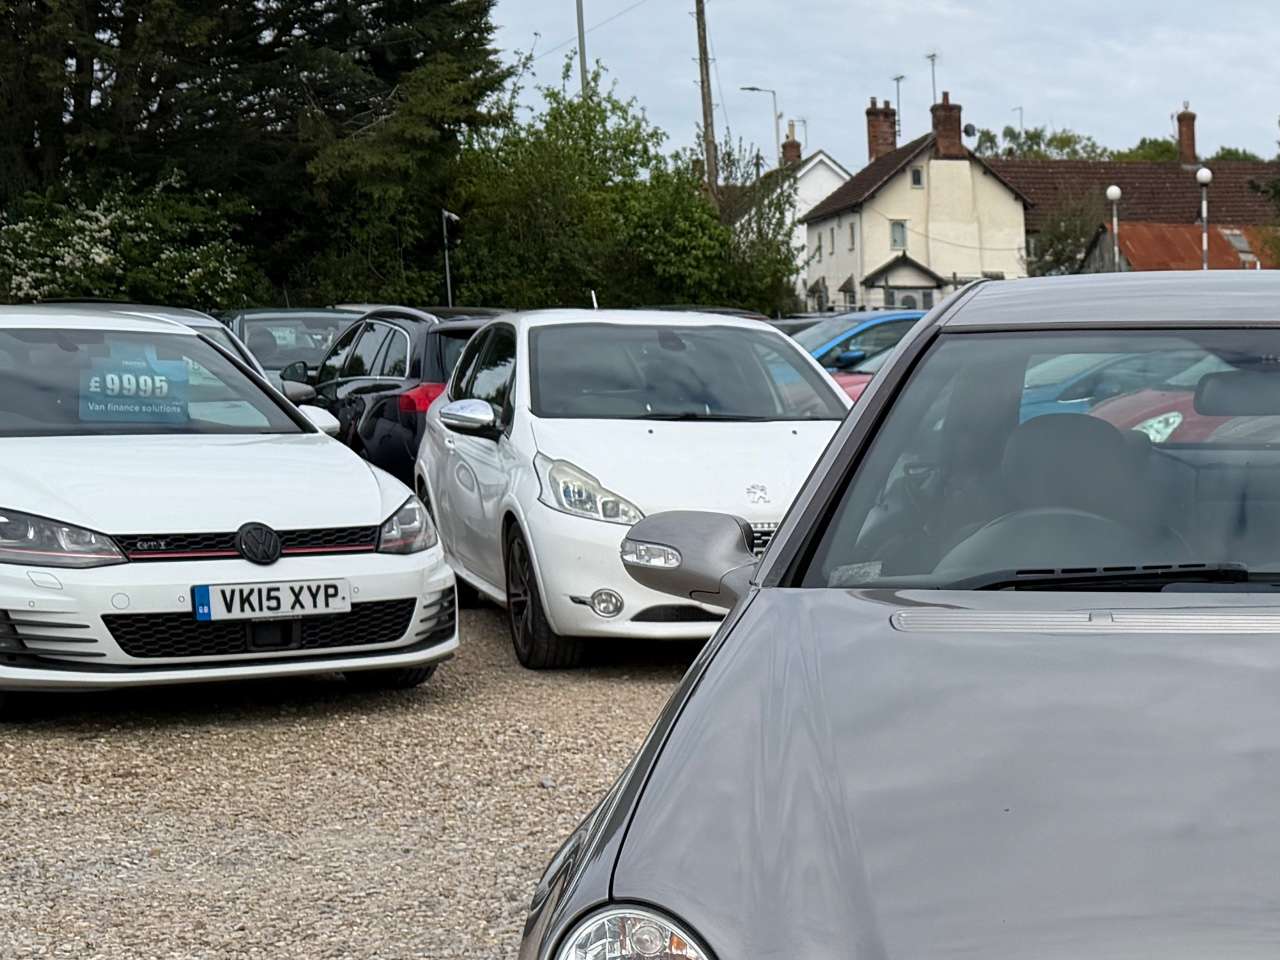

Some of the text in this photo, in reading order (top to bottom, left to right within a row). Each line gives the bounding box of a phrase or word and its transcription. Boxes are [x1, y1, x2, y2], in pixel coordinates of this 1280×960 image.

[89, 373, 168, 397] £9995
[88, 402, 181, 413] Van finance solutions
[220, 584, 339, 613] VK15 XYP
